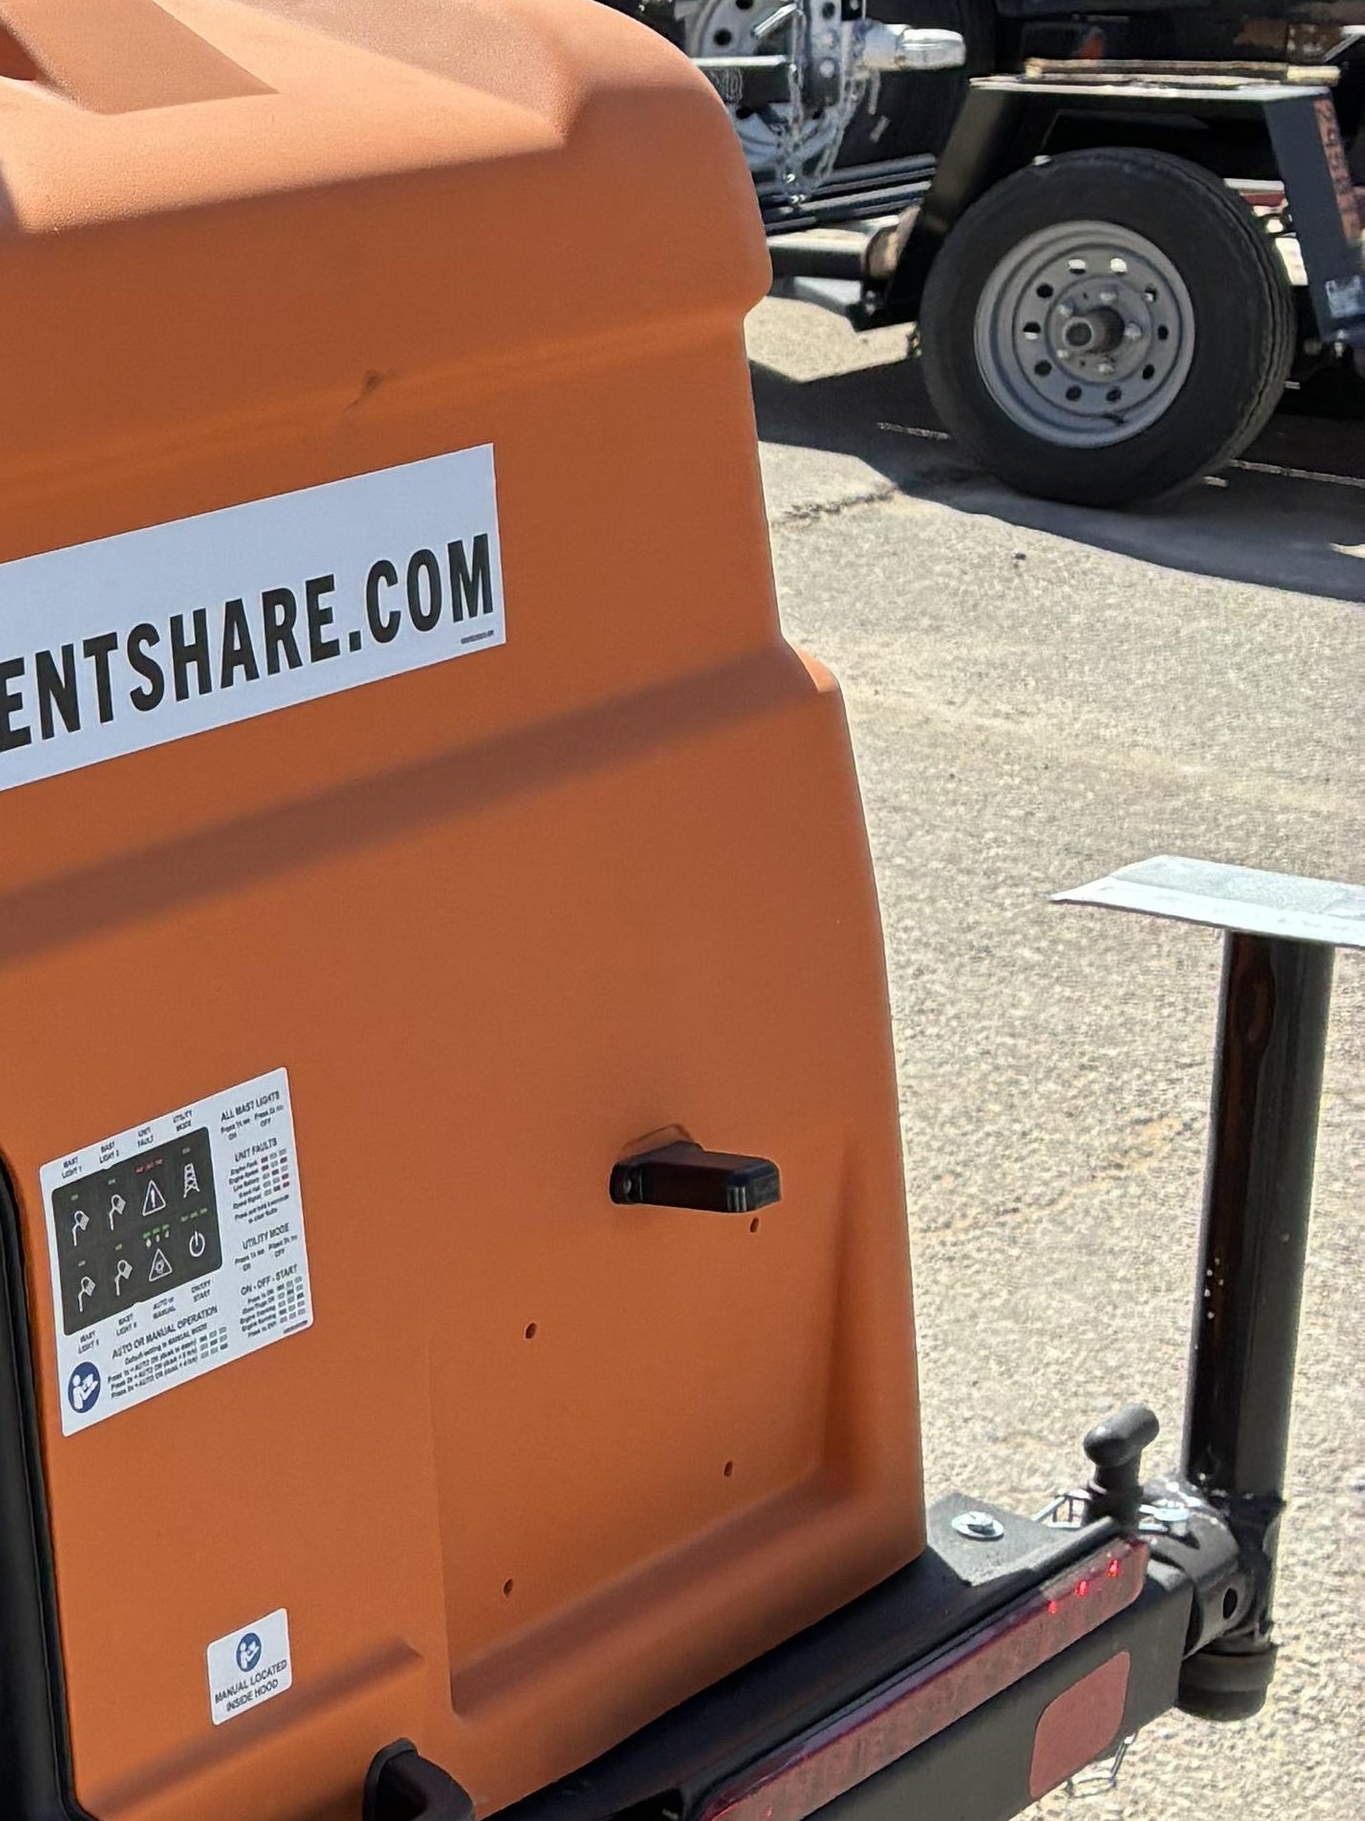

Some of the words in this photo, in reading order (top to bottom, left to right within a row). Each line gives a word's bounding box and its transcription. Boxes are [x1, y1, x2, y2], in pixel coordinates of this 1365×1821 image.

[242, 1232, 269, 1250] UTILITY
[112, 1343, 132, 1360] AUTO
[134, 1337, 145, 1349] OR
[146, 1325, 176, 1345] MANUAL
[177, 1305, 218, 1330] OPERATION
[215, 1680, 248, 1703] MANUAL
[250, 1659, 288, 1686] LOCATED
[226, 1691, 254, 1712] INSIDE
[255, 1679, 278, 1698] HOOD
